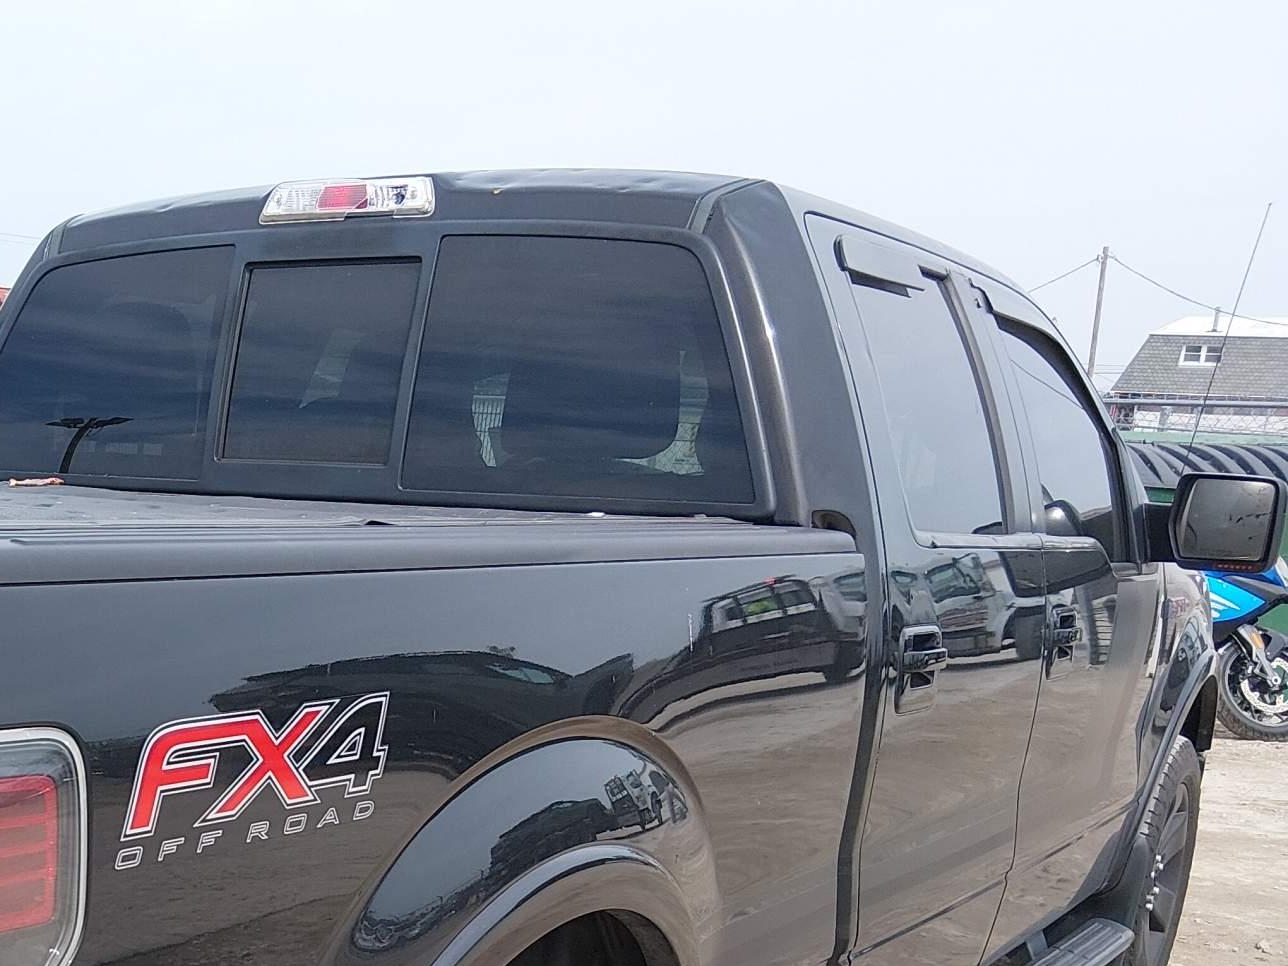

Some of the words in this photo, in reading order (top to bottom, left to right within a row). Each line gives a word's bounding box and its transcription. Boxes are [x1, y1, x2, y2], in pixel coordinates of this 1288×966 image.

[119, 690, 392, 842] FX4
[114, 829, 224, 871] OFF
[245, 800, 376, 844] ROAD
